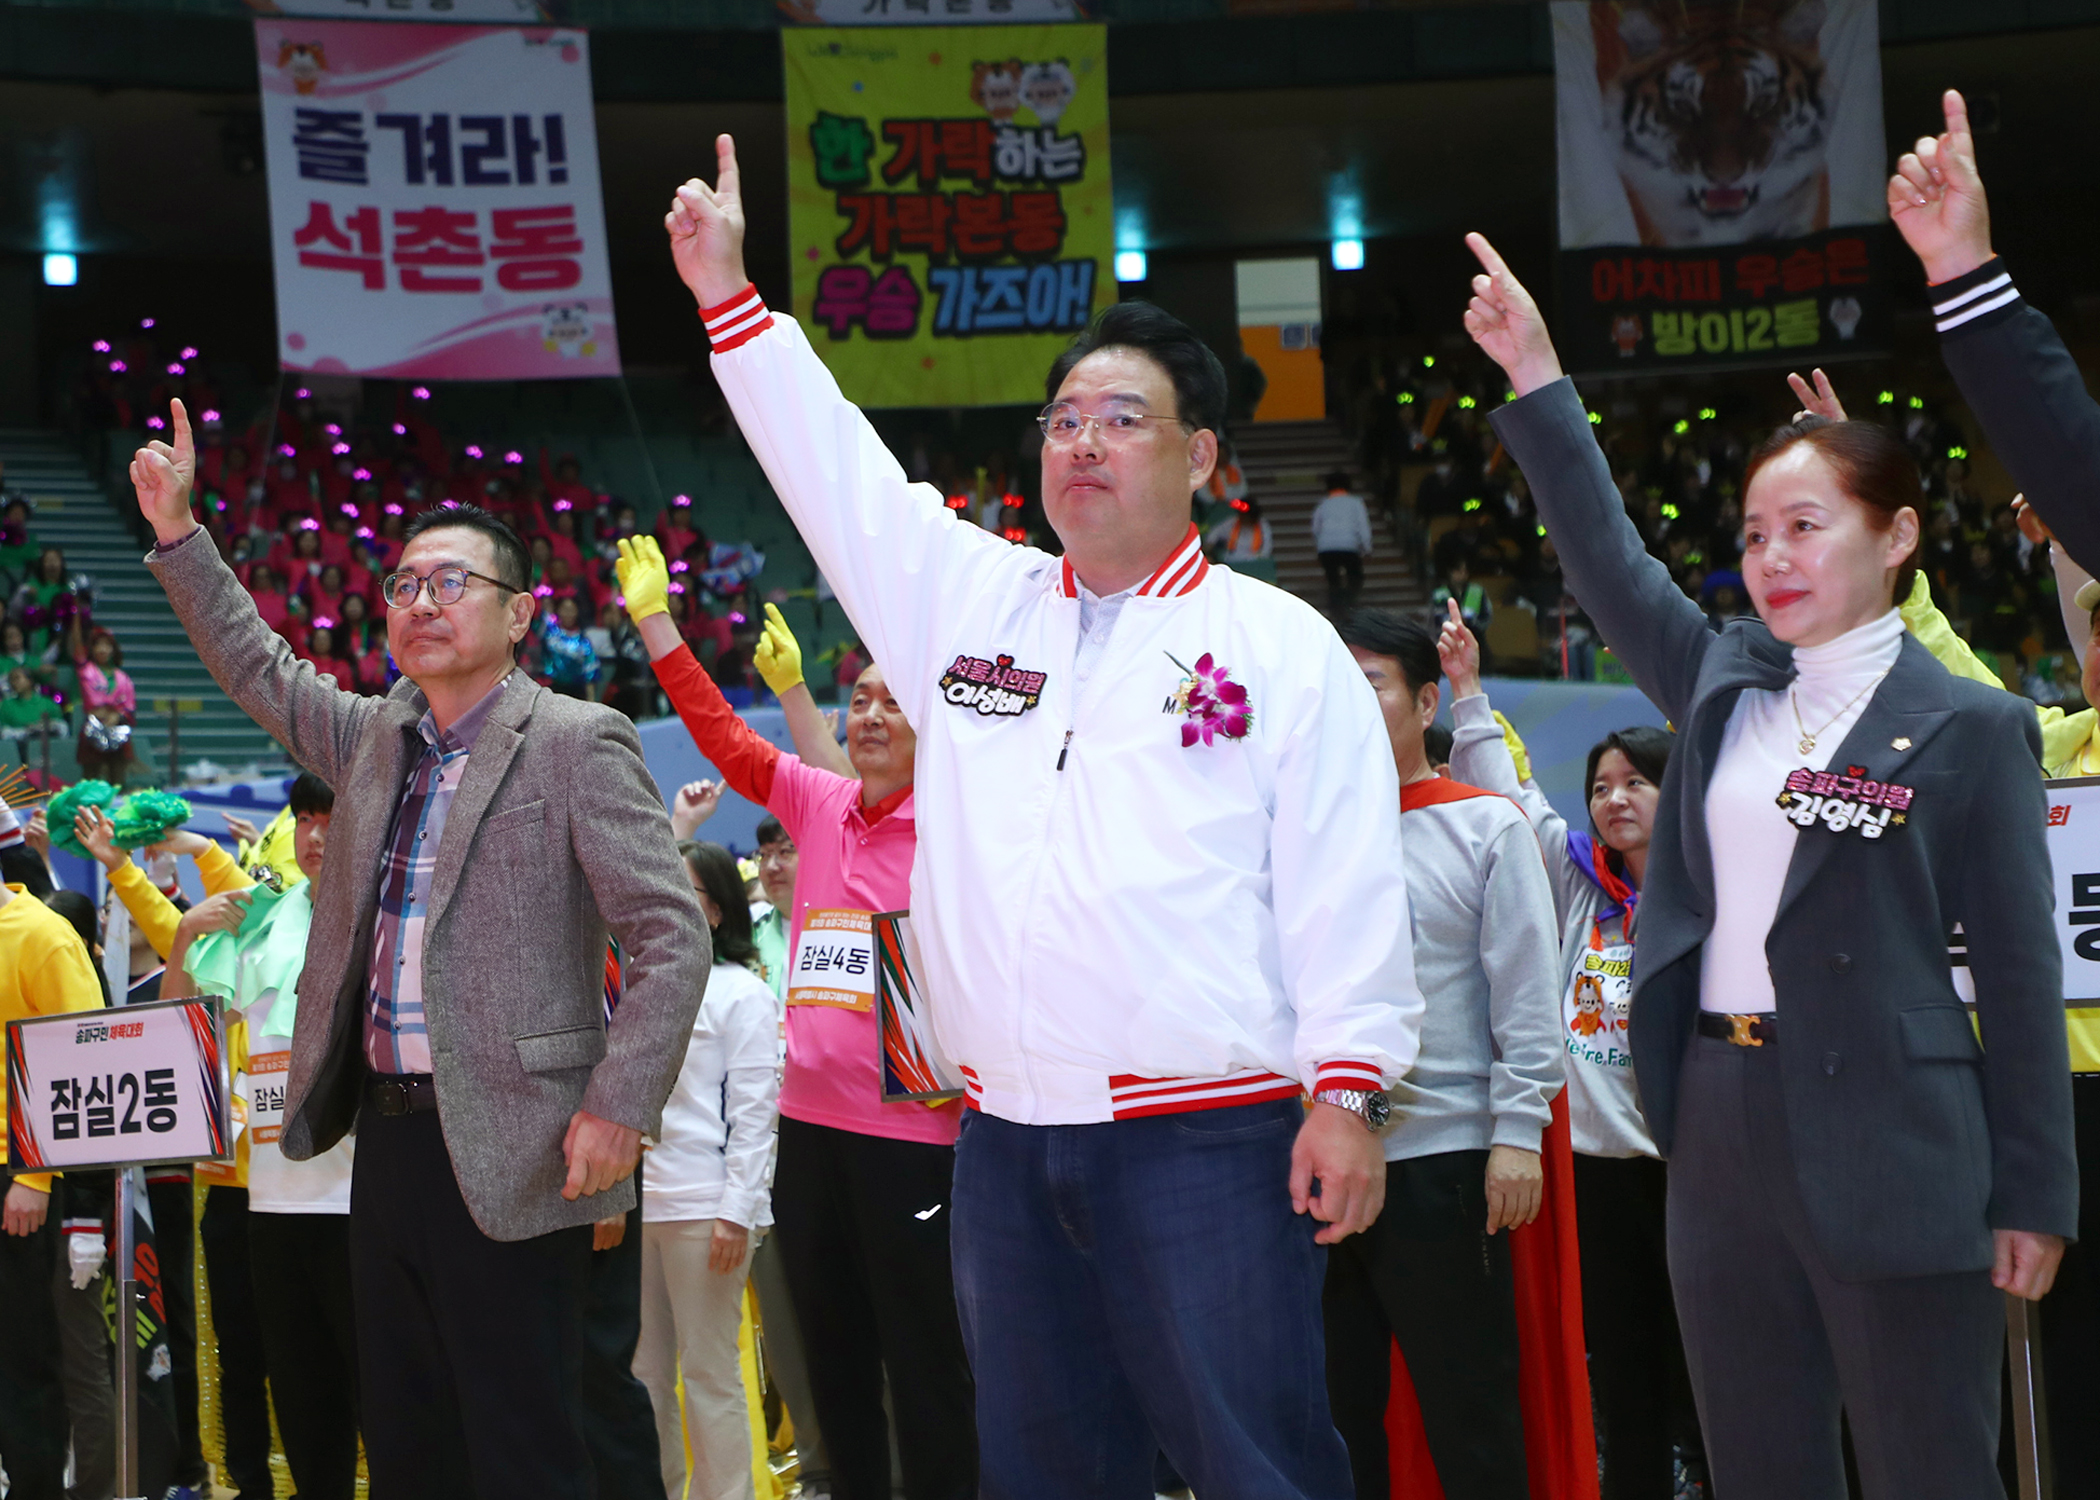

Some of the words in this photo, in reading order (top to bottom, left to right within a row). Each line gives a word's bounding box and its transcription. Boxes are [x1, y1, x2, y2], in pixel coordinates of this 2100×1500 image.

[293, 107, 569, 187] 즐겨라!
[811, 111, 876, 190] 한
[882, 116, 1086, 190] 가락하는
[293, 200, 584, 293] 석촌동
[836, 189, 1067, 262] 가락본동
[1592, 257, 1722, 302] 어차피
[1735, 238, 1870, 299] 우승은
[814, 263, 922, 340] 우승
[928, 259, 1097, 337] 가즈아!
[1652, 298, 1821, 356] 방이2동
[945, 681, 1027, 714] 이성배
[946, 655, 1046, 695] 서울시의원
[1785, 767, 1915, 811] 송파구의원
[1788, 791, 1893, 839] 김영심
[800, 945, 871, 975] 잠실4동
[75, 1025, 109, 1044] 송파구민
[109, 1022, 144, 1040] 체육대회
[1565, 1037, 1604, 1065] e're
[51, 1068, 178, 1141] 잠실2동
[254, 1086, 284, 1112] 잠실
